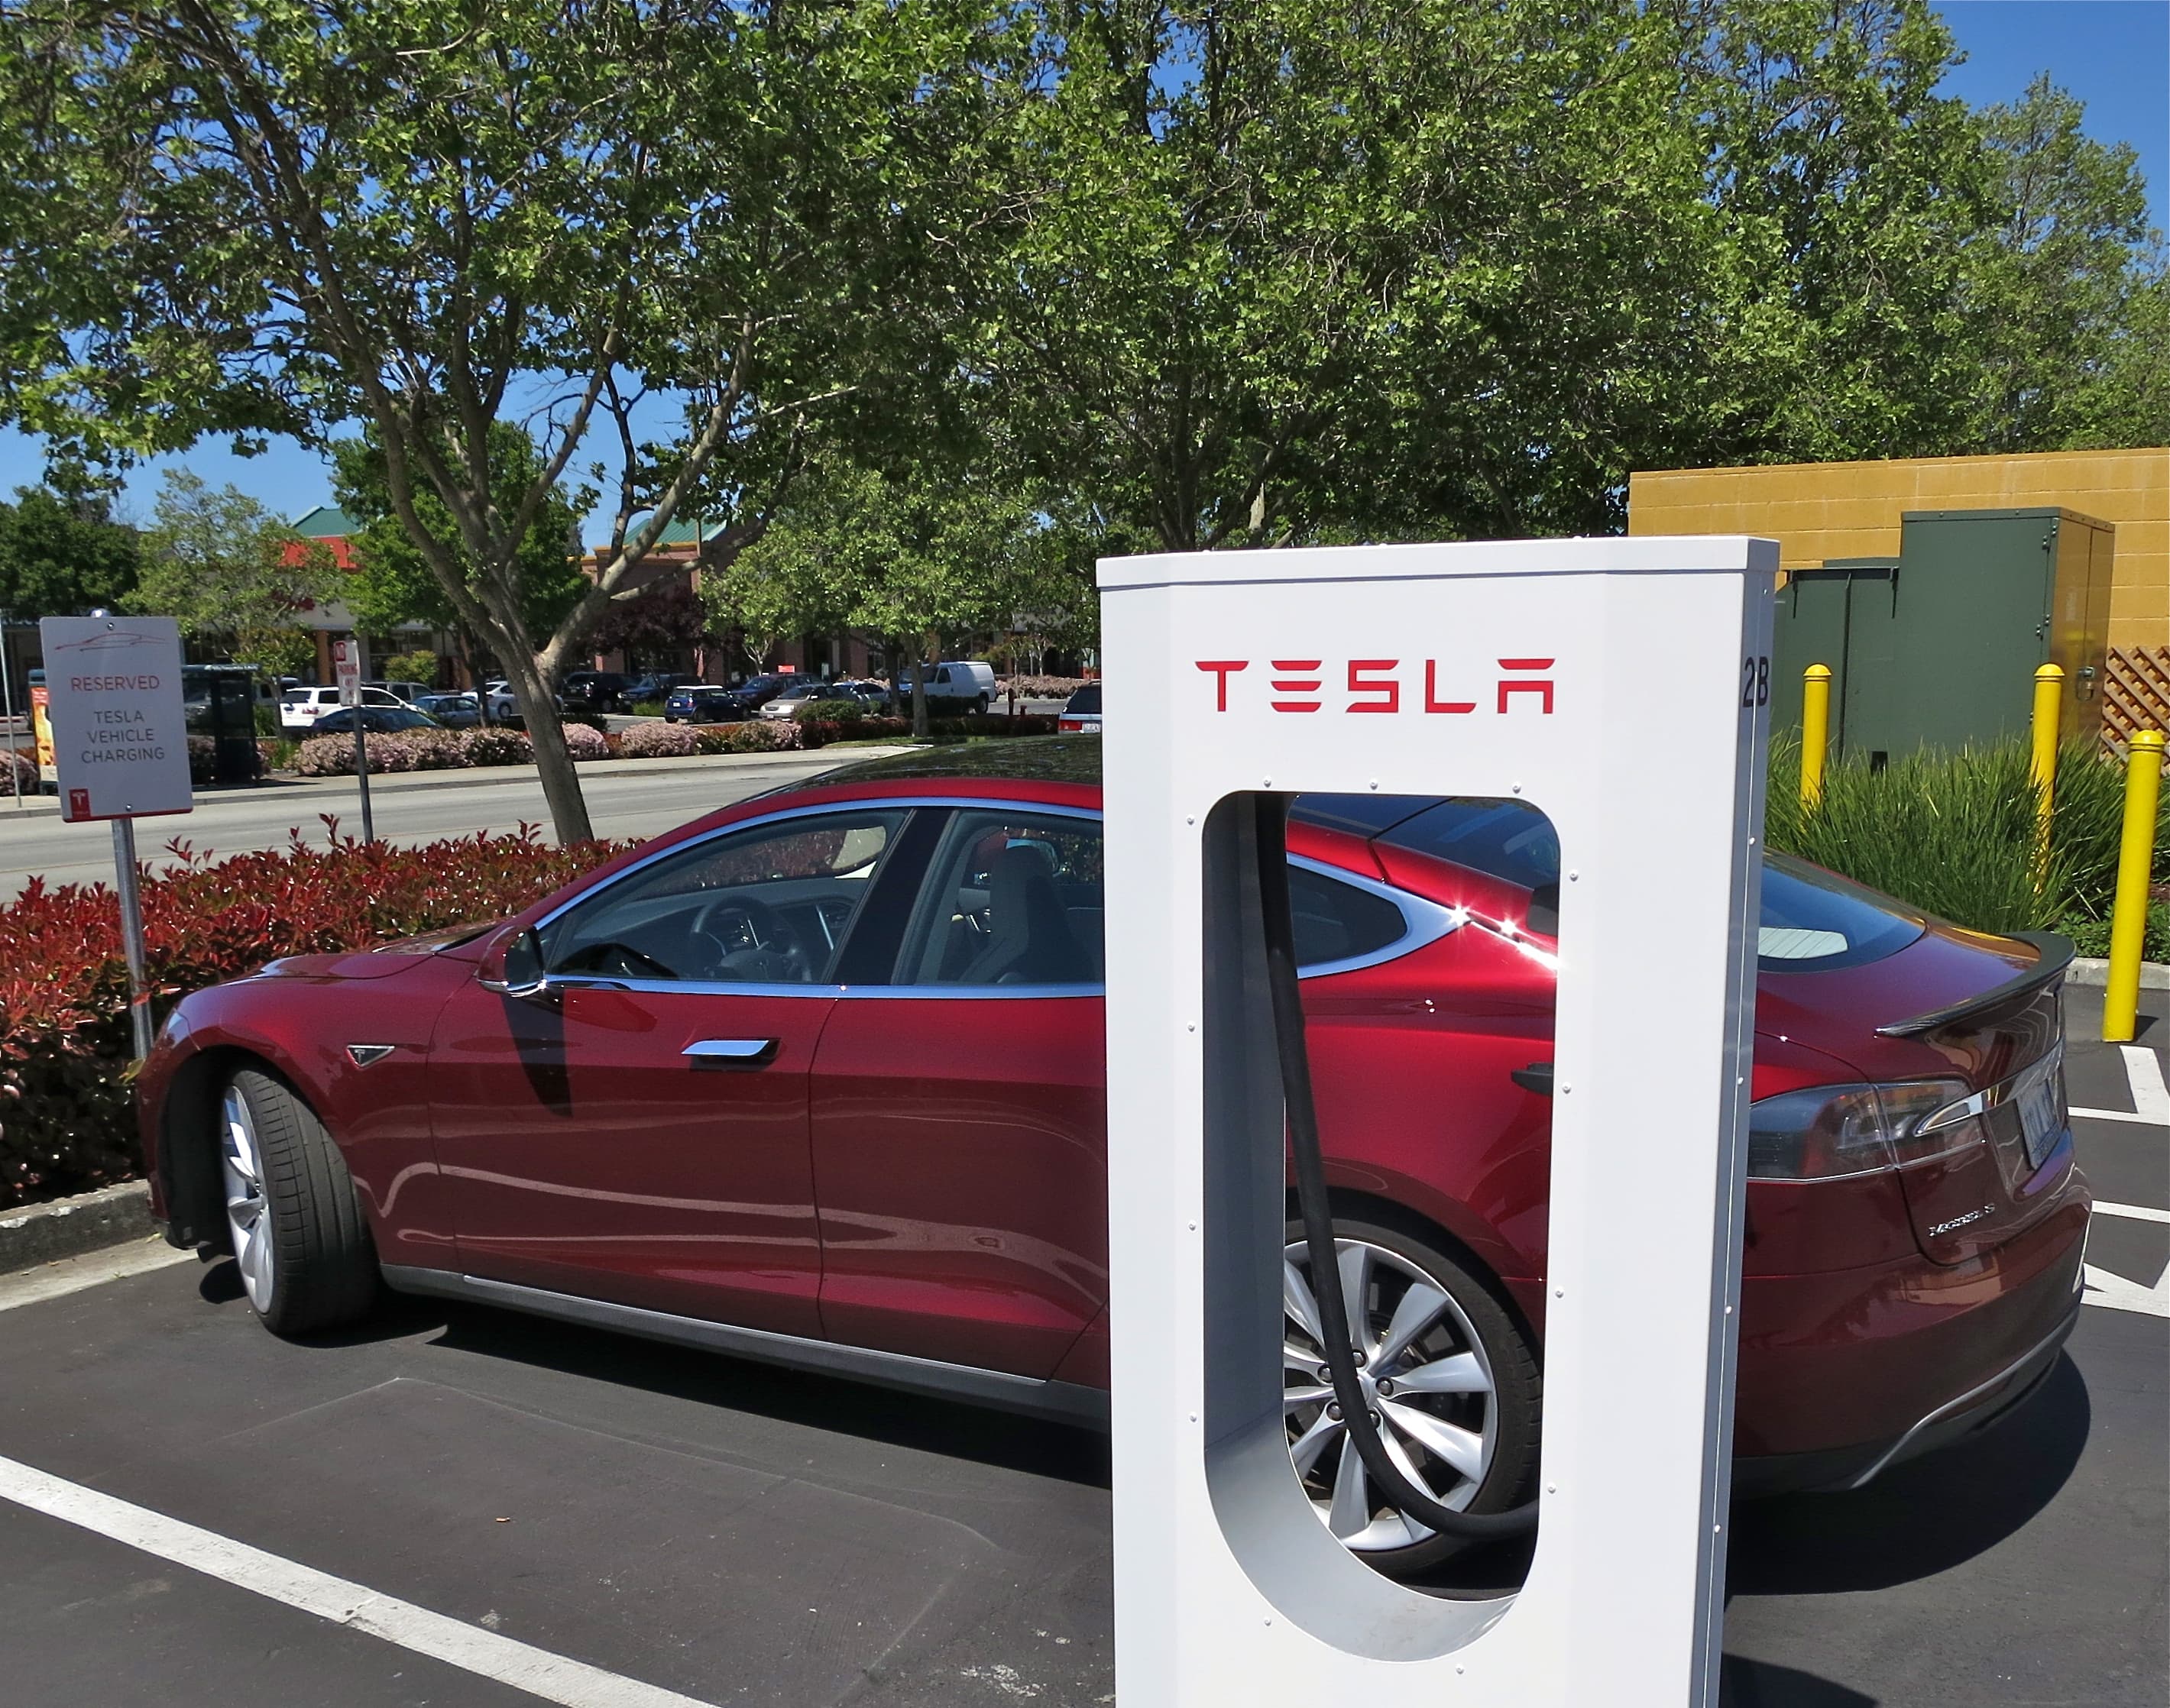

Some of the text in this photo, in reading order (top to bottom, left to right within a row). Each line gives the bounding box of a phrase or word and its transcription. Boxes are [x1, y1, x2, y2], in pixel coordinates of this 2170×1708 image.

[70, 675, 160, 692] RESERVED
[1194, 658, 1556, 714] TESLA
[1743, 656, 1769, 707] 2B
[93, 710, 145, 724] TESLA
[86, 728, 156, 744] VEHICLE
[81, 746, 165, 764] CHARGING
